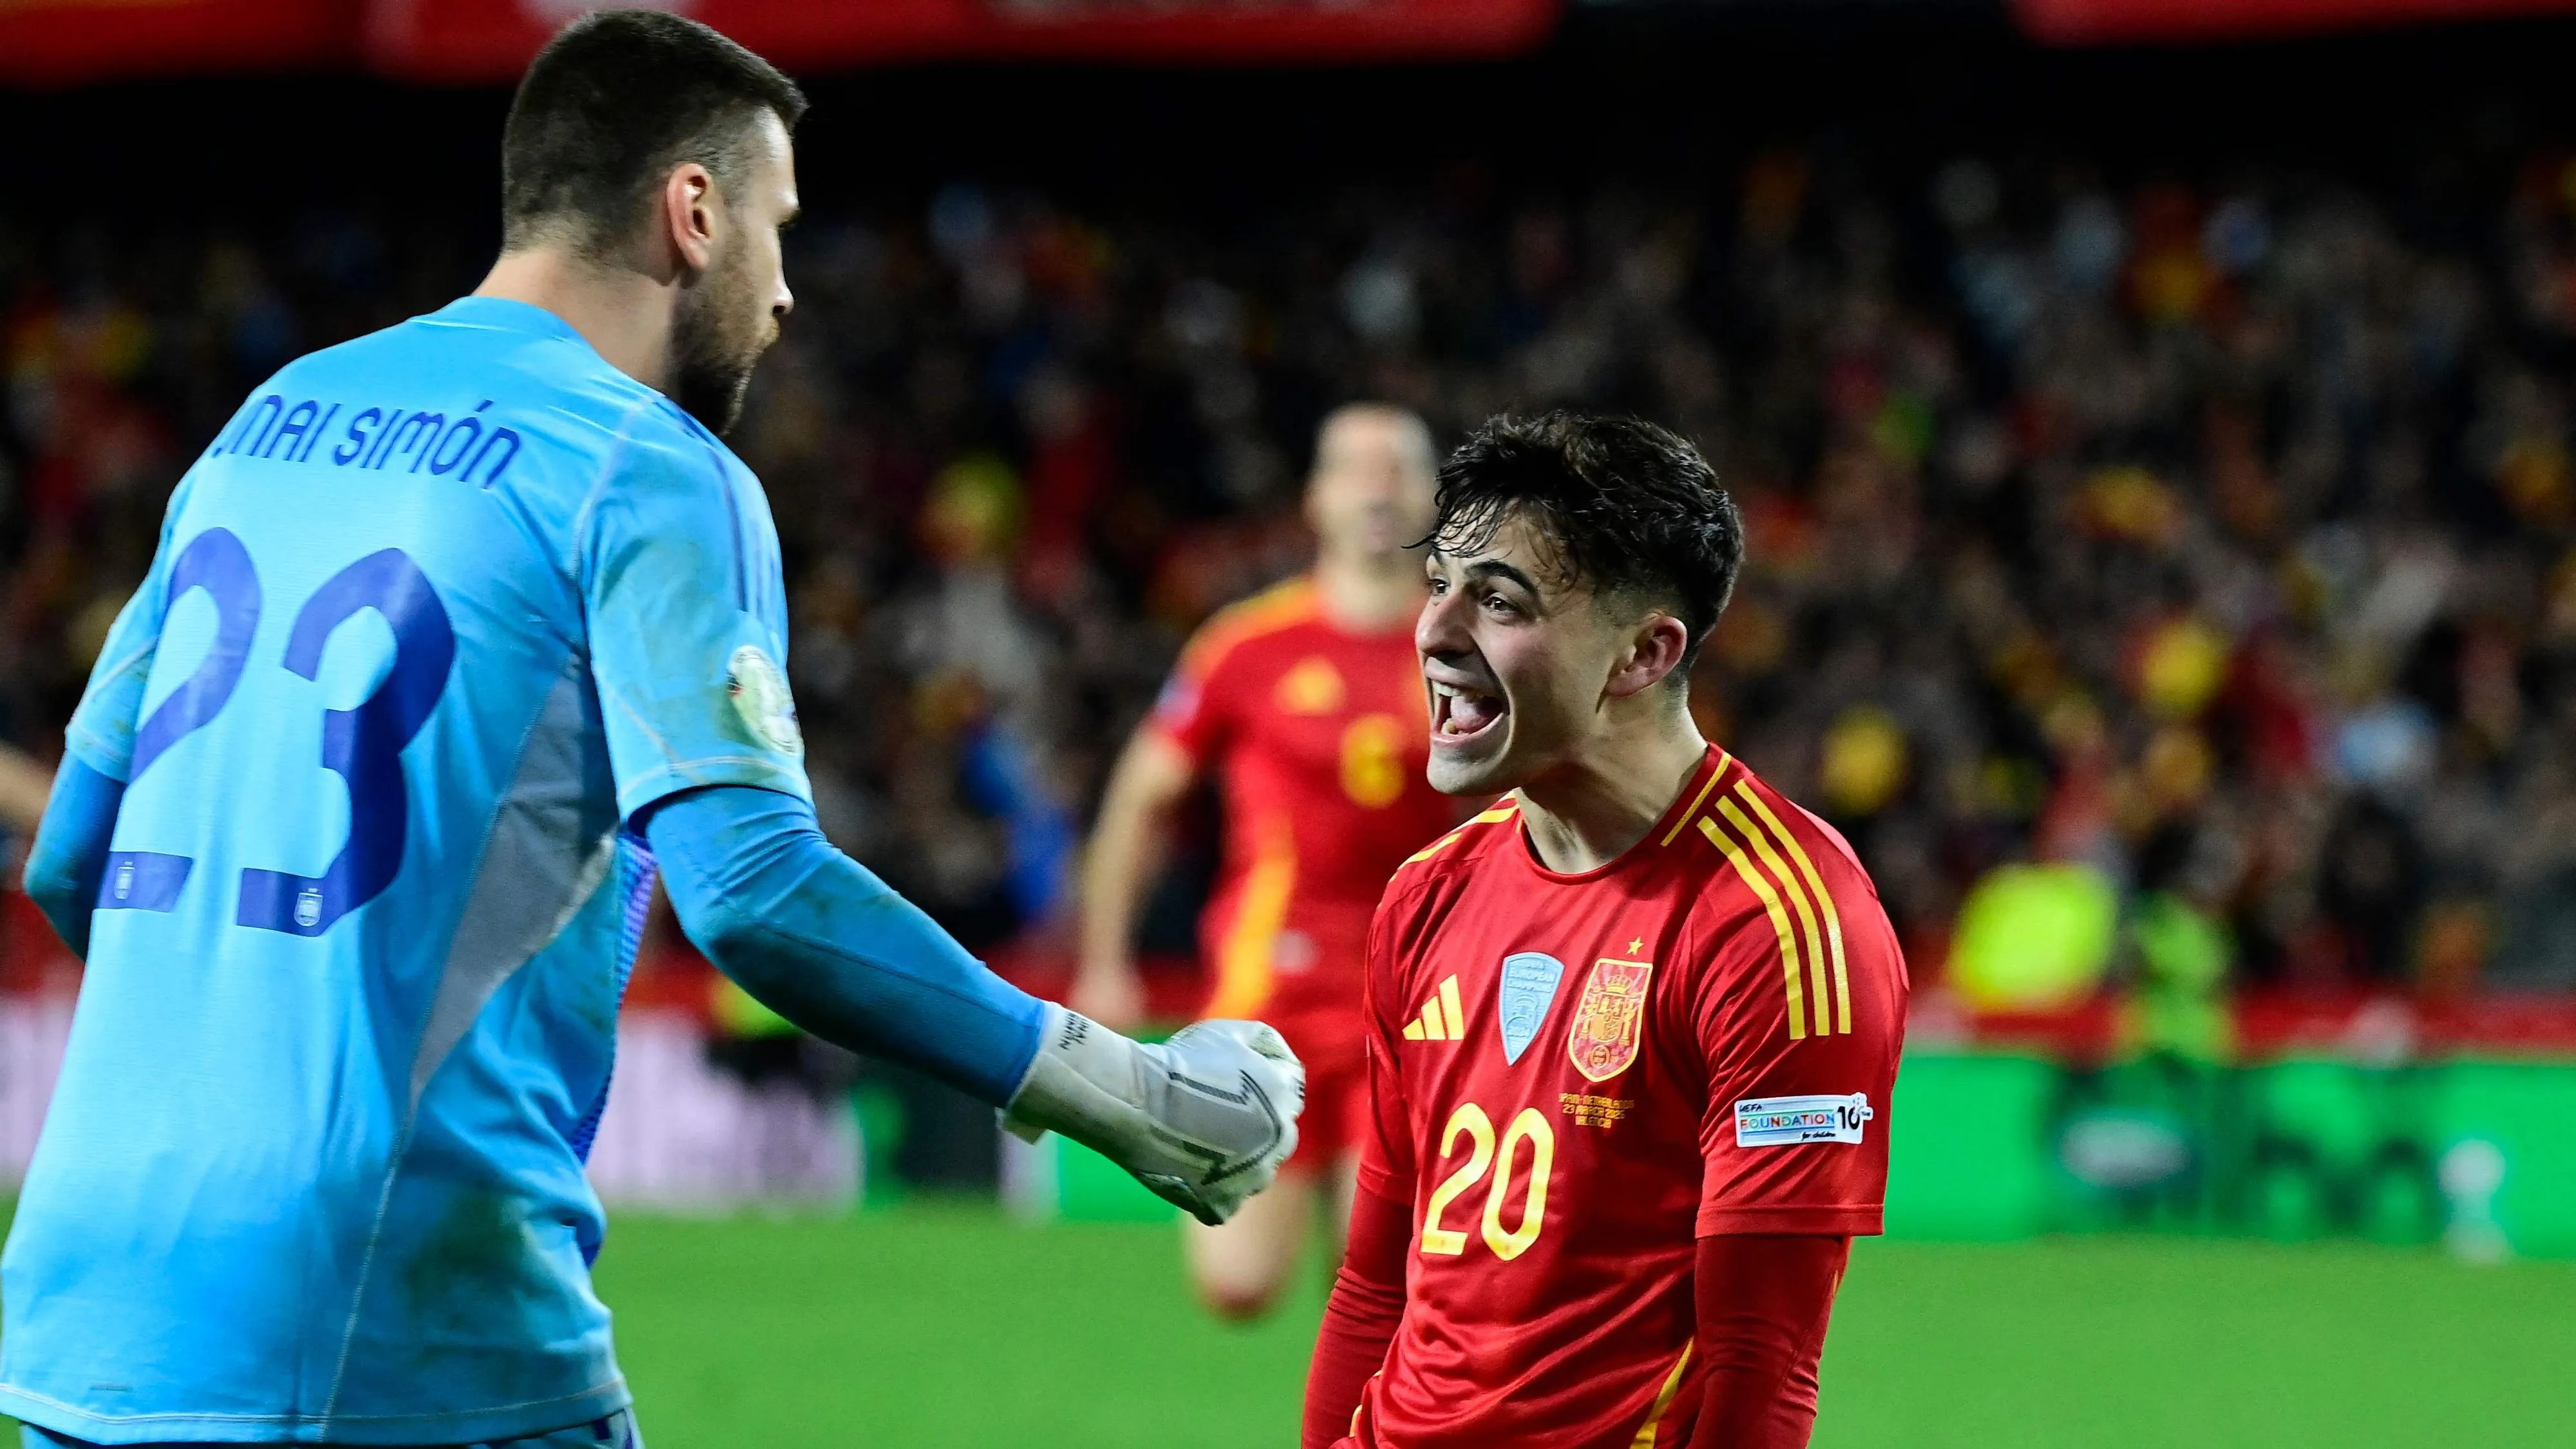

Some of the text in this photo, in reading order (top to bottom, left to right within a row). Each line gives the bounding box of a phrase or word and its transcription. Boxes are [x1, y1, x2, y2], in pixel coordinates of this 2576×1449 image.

[211, 395, 520, 491] NAI SIMÓN
[95, 527, 456, 938] 23
[1739, 1103, 1763, 1113] UEFA
[1740, 1113, 1835, 1130] FOUNDATION
[1421, 1102, 1555, 1262] 20
